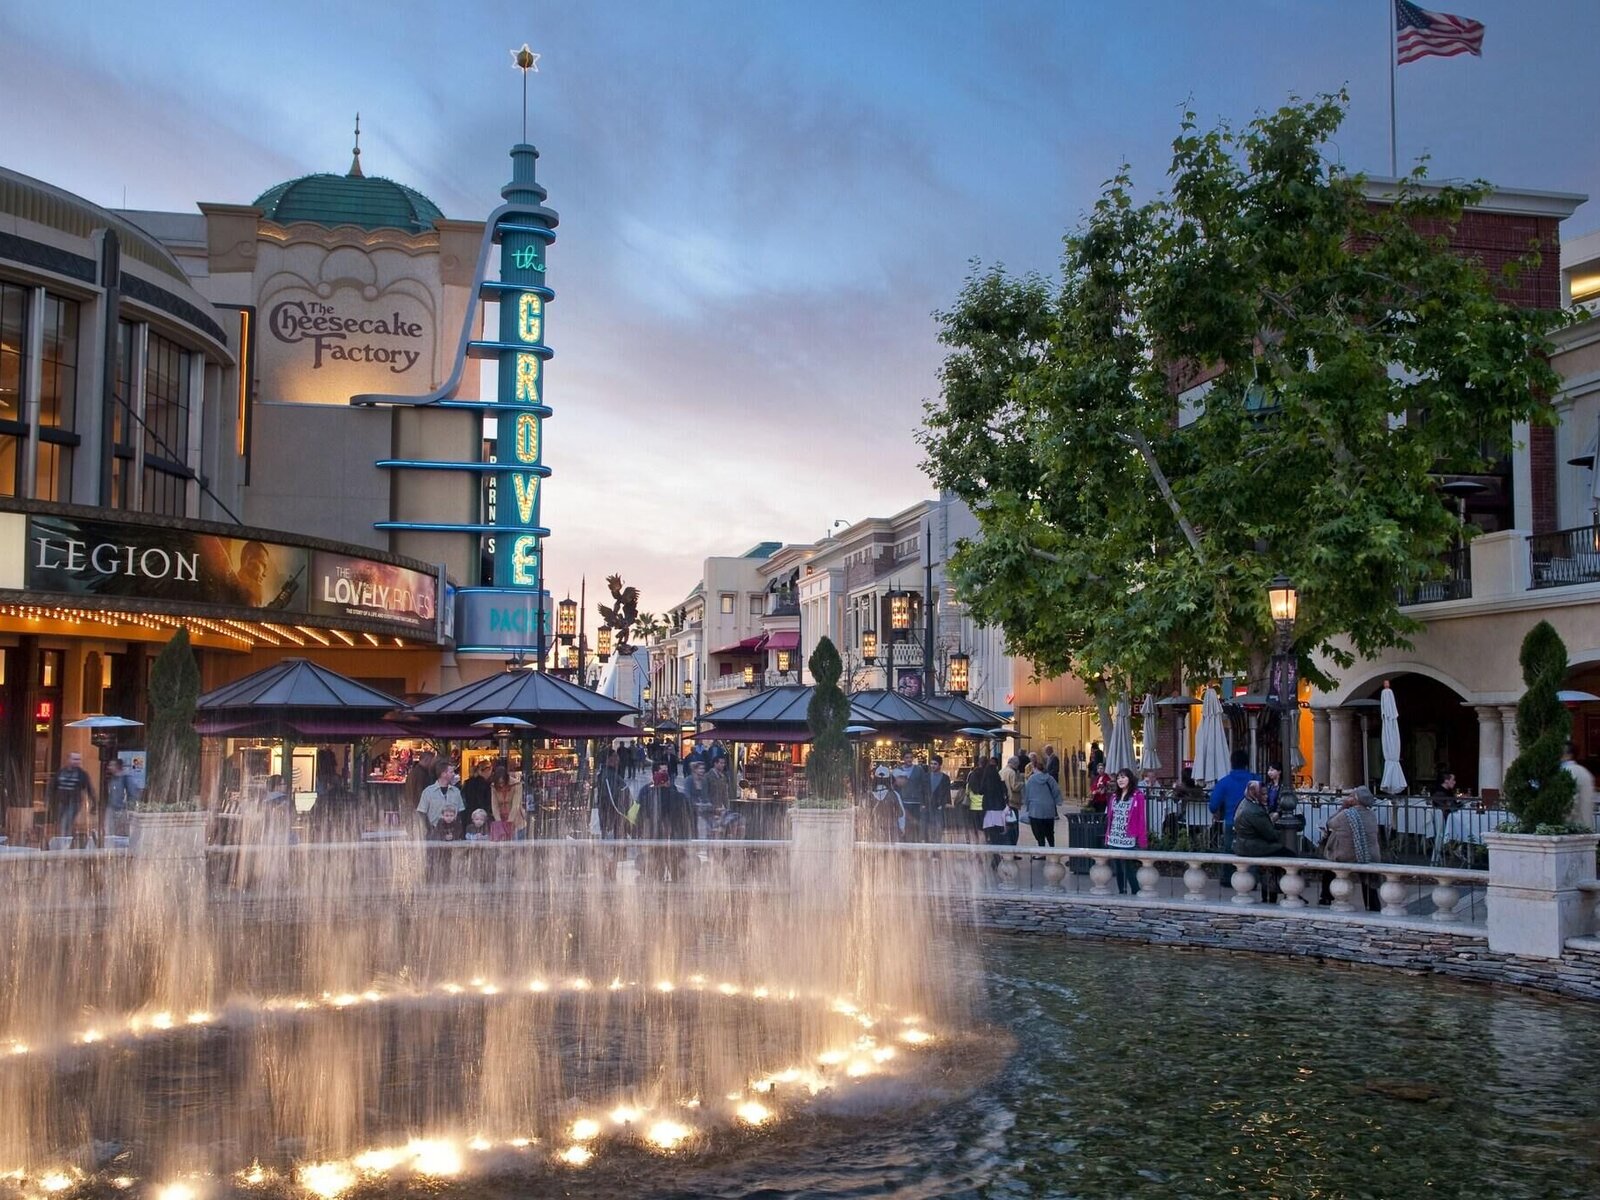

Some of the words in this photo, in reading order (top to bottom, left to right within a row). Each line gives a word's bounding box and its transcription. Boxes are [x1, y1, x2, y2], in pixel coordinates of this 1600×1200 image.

[511, 245, 547, 273] the
[269, 301, 423, 344] Cheesecake
[307, 301, 335, 316] The
[301, 331, 420, 374] Factory
[511, 292, 542, 586] GROVE
[35, 536, 200, 582] LEGION
[335, 566, 351, 578] THE
[324, 575, 389, 609] LOVELY
[392, 588, 431, 620] BONES
